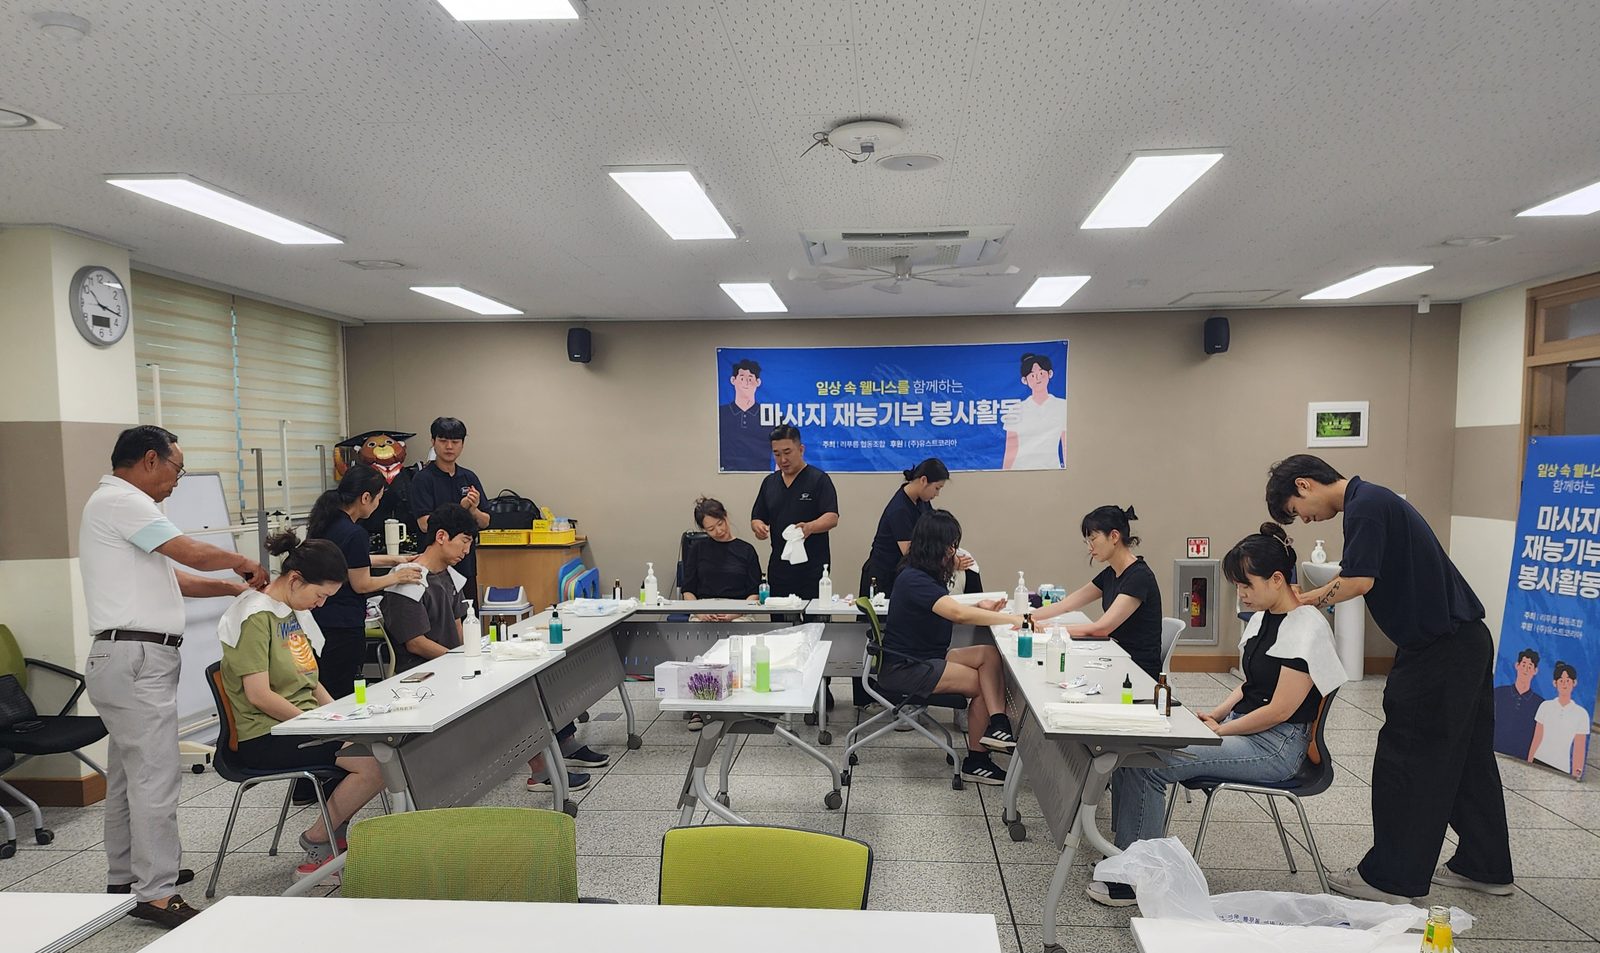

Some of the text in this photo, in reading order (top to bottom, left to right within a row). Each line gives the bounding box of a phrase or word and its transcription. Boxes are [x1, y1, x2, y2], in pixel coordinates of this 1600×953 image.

[96, 274, 104, 285] 12
[113, 290, 118, 300] 2
[99, 328, 104, 338] 6
[816, 379, 964, 395] 일상 속 웰니스를 함께하는
[760, 398, 1023, 427] 마사지 재능기부 봉사활동
[889, 439, 903, 448] 후원
[1537, 463, 1558, 478] 일상
[1559, 463, 1571, 478] 속
[1552, 479, 1595, 494] 함께하는
[1536, 505, 1600, 535] 마사지
[1521, 535, 1600, 567] 재능기부
[1518, 564, 1600, 599] 봉사활동
